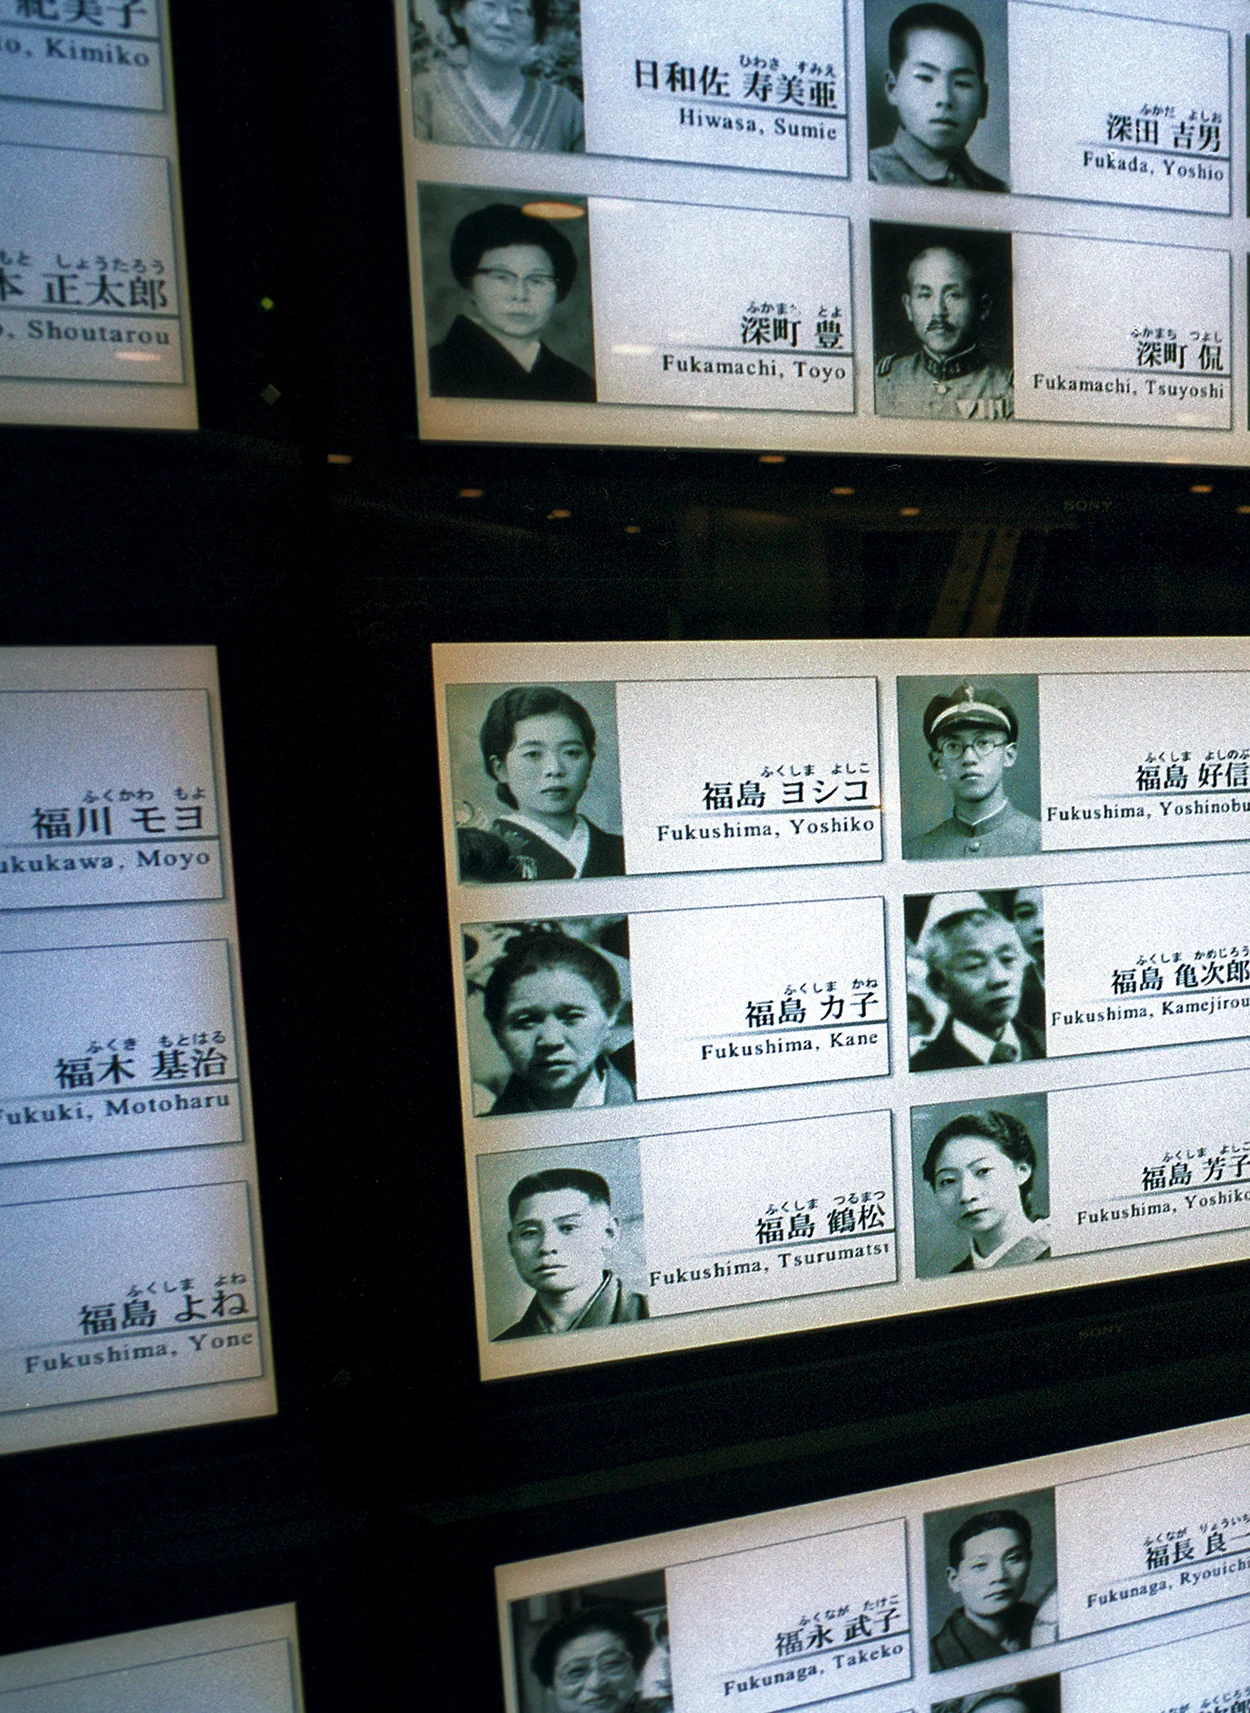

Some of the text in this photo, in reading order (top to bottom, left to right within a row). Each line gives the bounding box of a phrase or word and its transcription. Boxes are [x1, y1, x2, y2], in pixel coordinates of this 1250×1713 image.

[45, 37, 150, 67] Kimiko
[739, 54, 836, 77] ひわさ すみえ
[635, 59, 837, 109] 日和佐 寿美亜
[680, 108, 837, 140] Hiwasa, Sumie
[1188, 110, 1222, 123] よしお
[1107, 113, 1221, 152] 深田 吉男
[1084, 151, 1224, 181] Fukada, Yoshio
[56, 254, 165, 274] しょうたろう
[42, 274, 167, 310] 正太郎
[818, 305, 842, 318] とよ
[28, 319, 169, 345] Shoutarou
[741, 316, 843, 348] 深町 豊
[1190, 330, 1223, 343] つよし
[1137, 340, 1188, 369] 深町
[663, 355, 846, 383] Fukamachi, Toyo
[1034, 374, 1224, 400] Fukamachi, Tsuyoshi
[761, 762, 870, 778] ふくしま よしこ
[1145, 749, 1250, 763] ふくしま よしのぶ
[1136, 762, 1249, 791] 福島 好信
[83, 787, 206, 803] ふくかわ もよ
[703, 780, 868, 810] 福島 ヨシコ
[31, 805, 204, 840] 福川 モヨ
[1047, 804, 1152, 821] Fukushima,
[657, 817, 874, 842] Fukushima, Yoshiko
[137, 849, 210, 870] Moyo
[1137, 945, 1250, 966] ふくしま かめじろう
[784, 978, 878, 996] ふくしま かね
[1111, 959, 1250, 995] 福島 亀次郎
[745, 997, 807, 1028] 福島
[1052, 996, 1250, 1026] Fukushima, Kamejirou
[88, 1031, 226, 1052] ふくき もとはる
[701, 1032, 878, 1060] Fukushima, Kane
[55, 1048, 228, 1090] 福木 基治
[106, 1093, 230, 1117] Motoharu
[1220, 1141, 1250, 1155] よしこ
[1142, 1162, 1192, 1191] 福島
[766, 1190, 886, 1215] ふくしま つるまつ
[1077, 1202, 1177, 1225] Fukushima,
[755, 1203, 885, 1245] 福島 鶴松
[128, 1272, 248, 1298] ふくしま よね
[650, 1260, 769, 1286] Fukushima,
[78, 1290, 249, 1336] 福島 よね
[25, 1331, 253, 1374] Fukushima, Yone
[1146, 1538, 1195, 1570] 福長
[1087, 1557, 1250, 1609] Fukunaga, Ryouichi
[799, 1594, 899, 1626] ふくなが たけこ
[775, 1607, 900, 1657] 福永 武子
[724, 1644, 903, 1696] Fukunaga, Takeko
